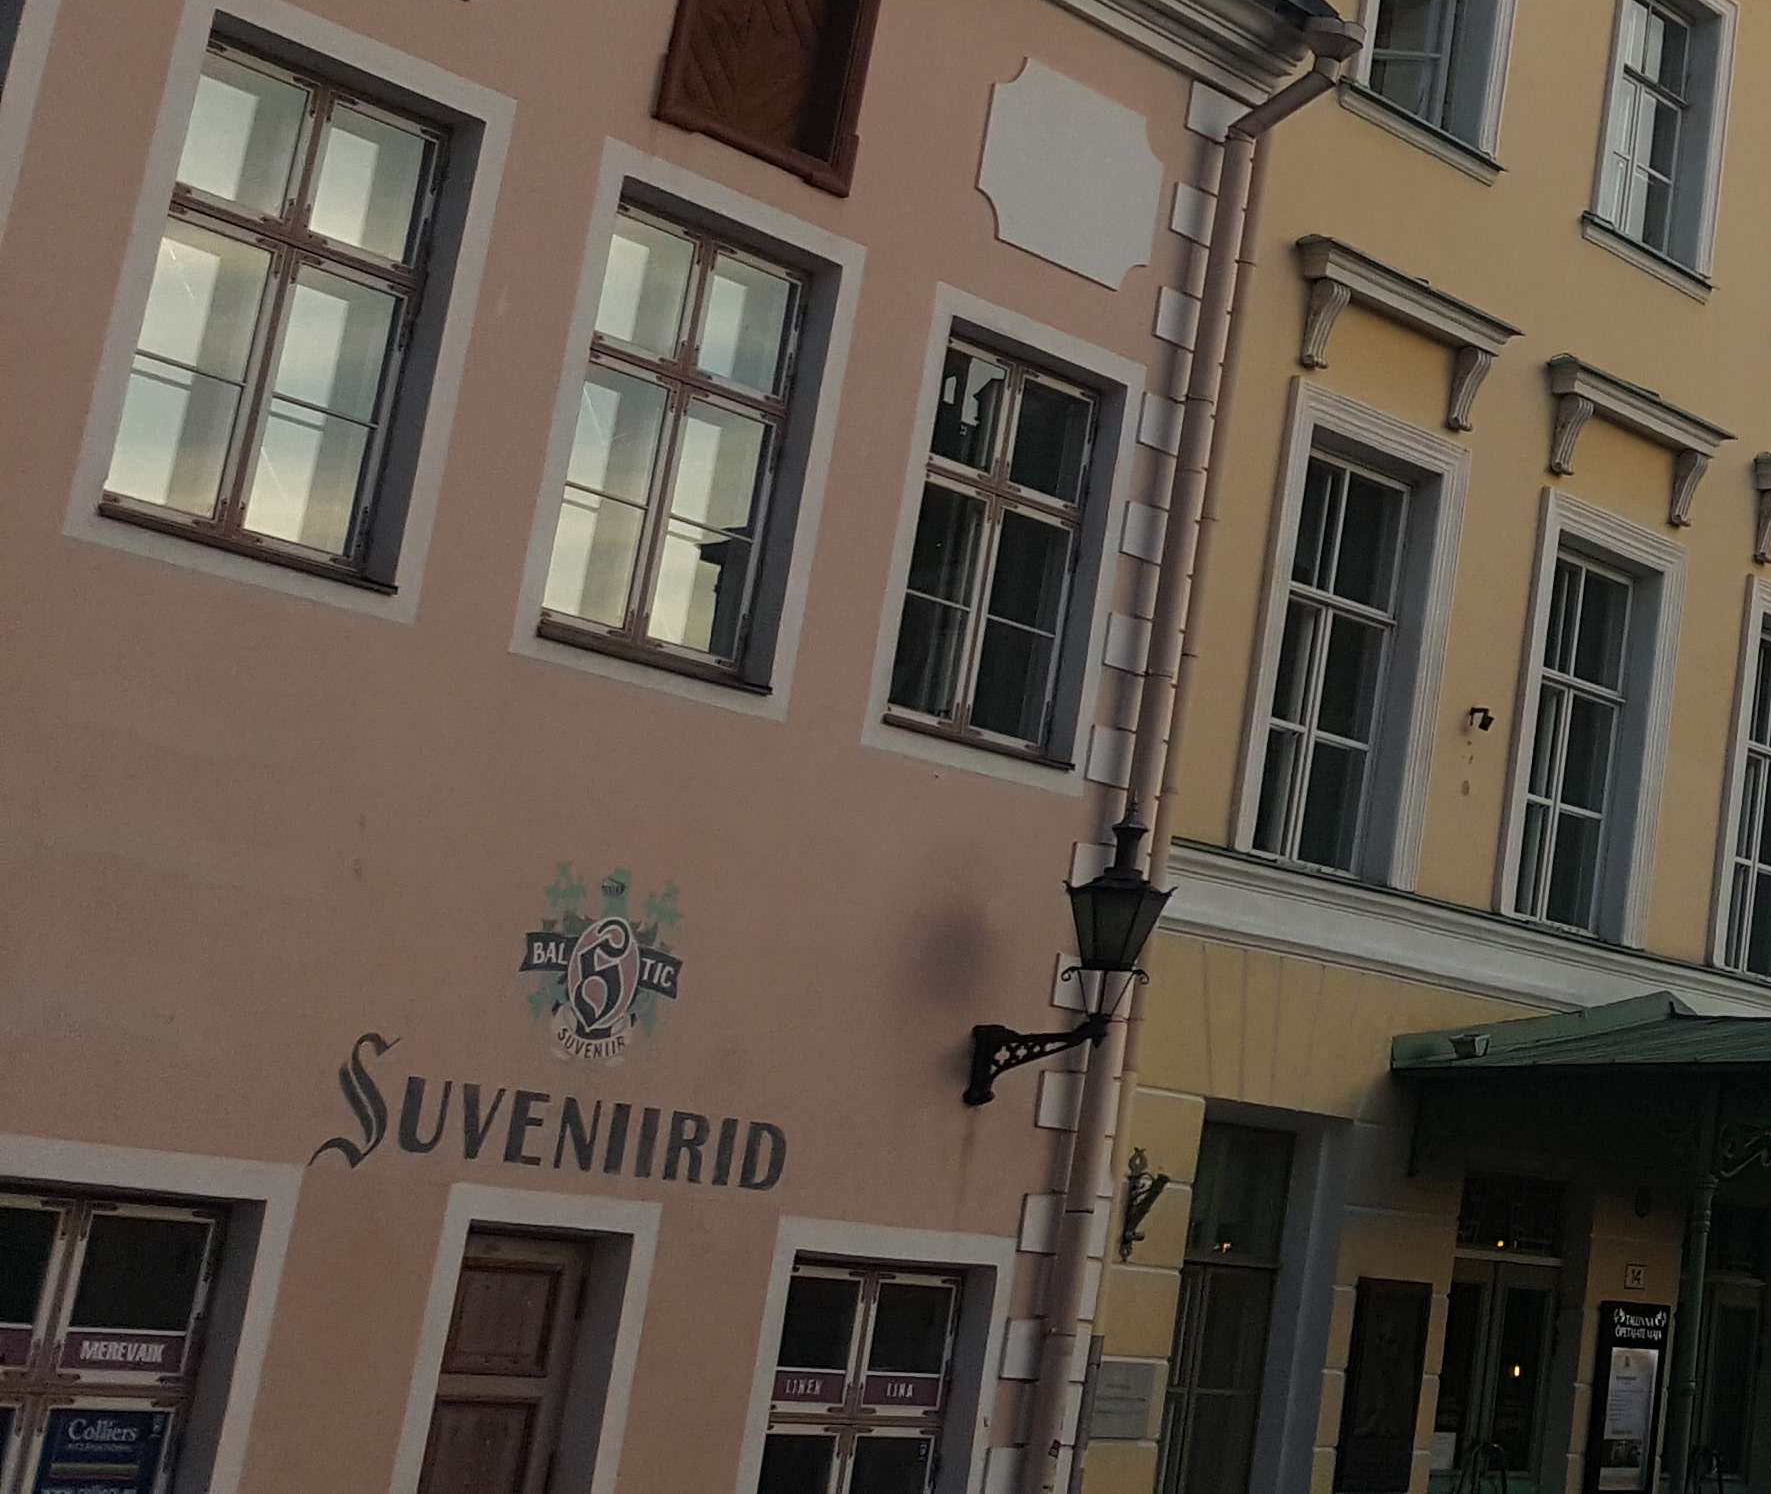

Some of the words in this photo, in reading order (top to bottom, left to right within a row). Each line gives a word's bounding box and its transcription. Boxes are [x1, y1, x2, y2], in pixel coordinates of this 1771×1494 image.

[557, 1027, 626, 1059] SUVENIIR
[308, 1033, 787, 1192] SUVENIIRID
[79, 1339, 168, 1363] MEREVAIK
[68, 1417, 139, 1443] Colliers
